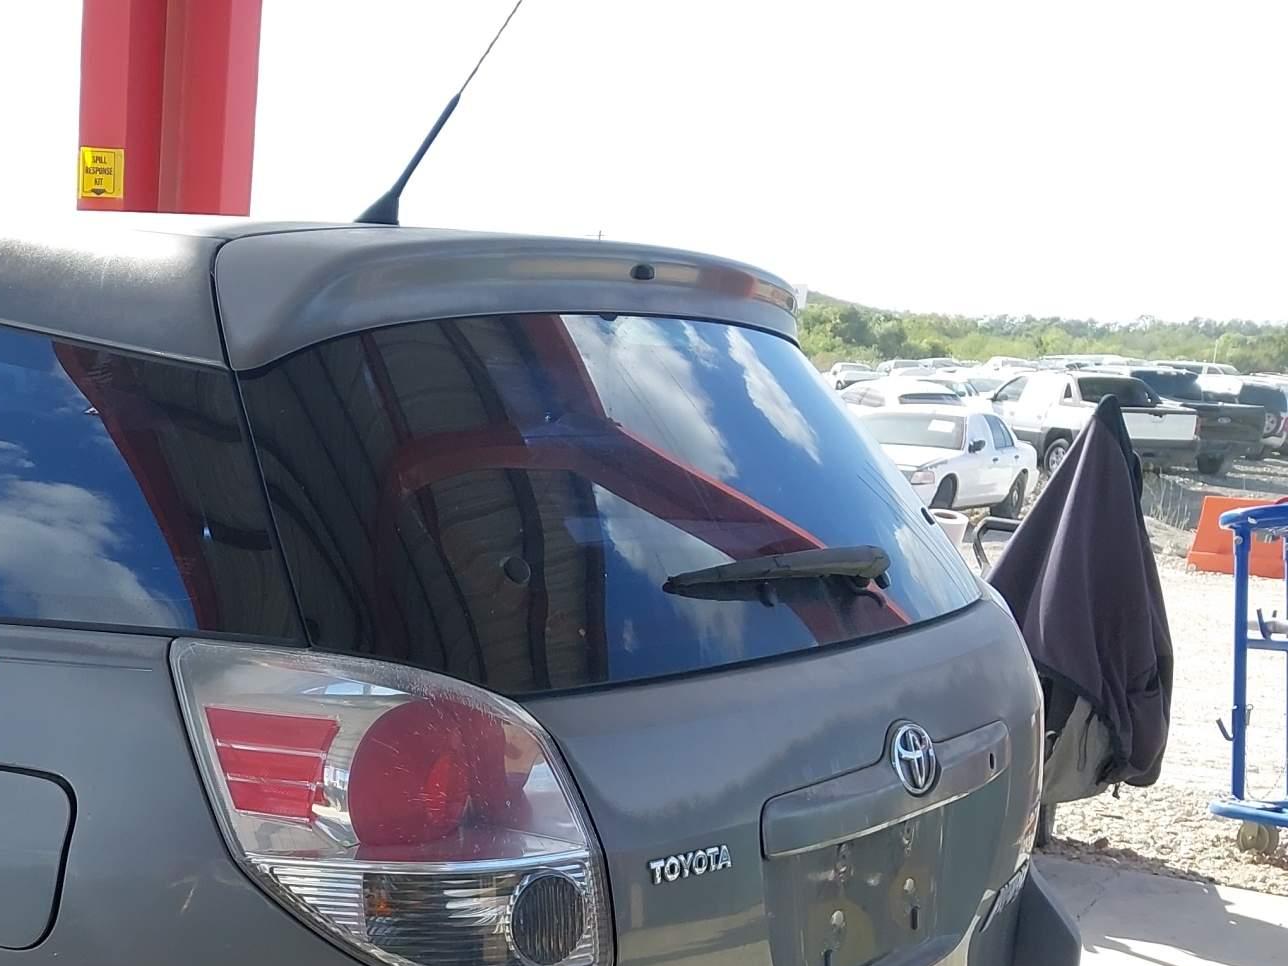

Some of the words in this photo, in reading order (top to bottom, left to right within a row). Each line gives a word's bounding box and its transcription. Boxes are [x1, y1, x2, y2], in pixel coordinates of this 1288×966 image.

[85, 166, 113, 175] RESPONSE
[94, 177, 104, 185] KIT
[649, 845, 732, 885] TOYOTA
